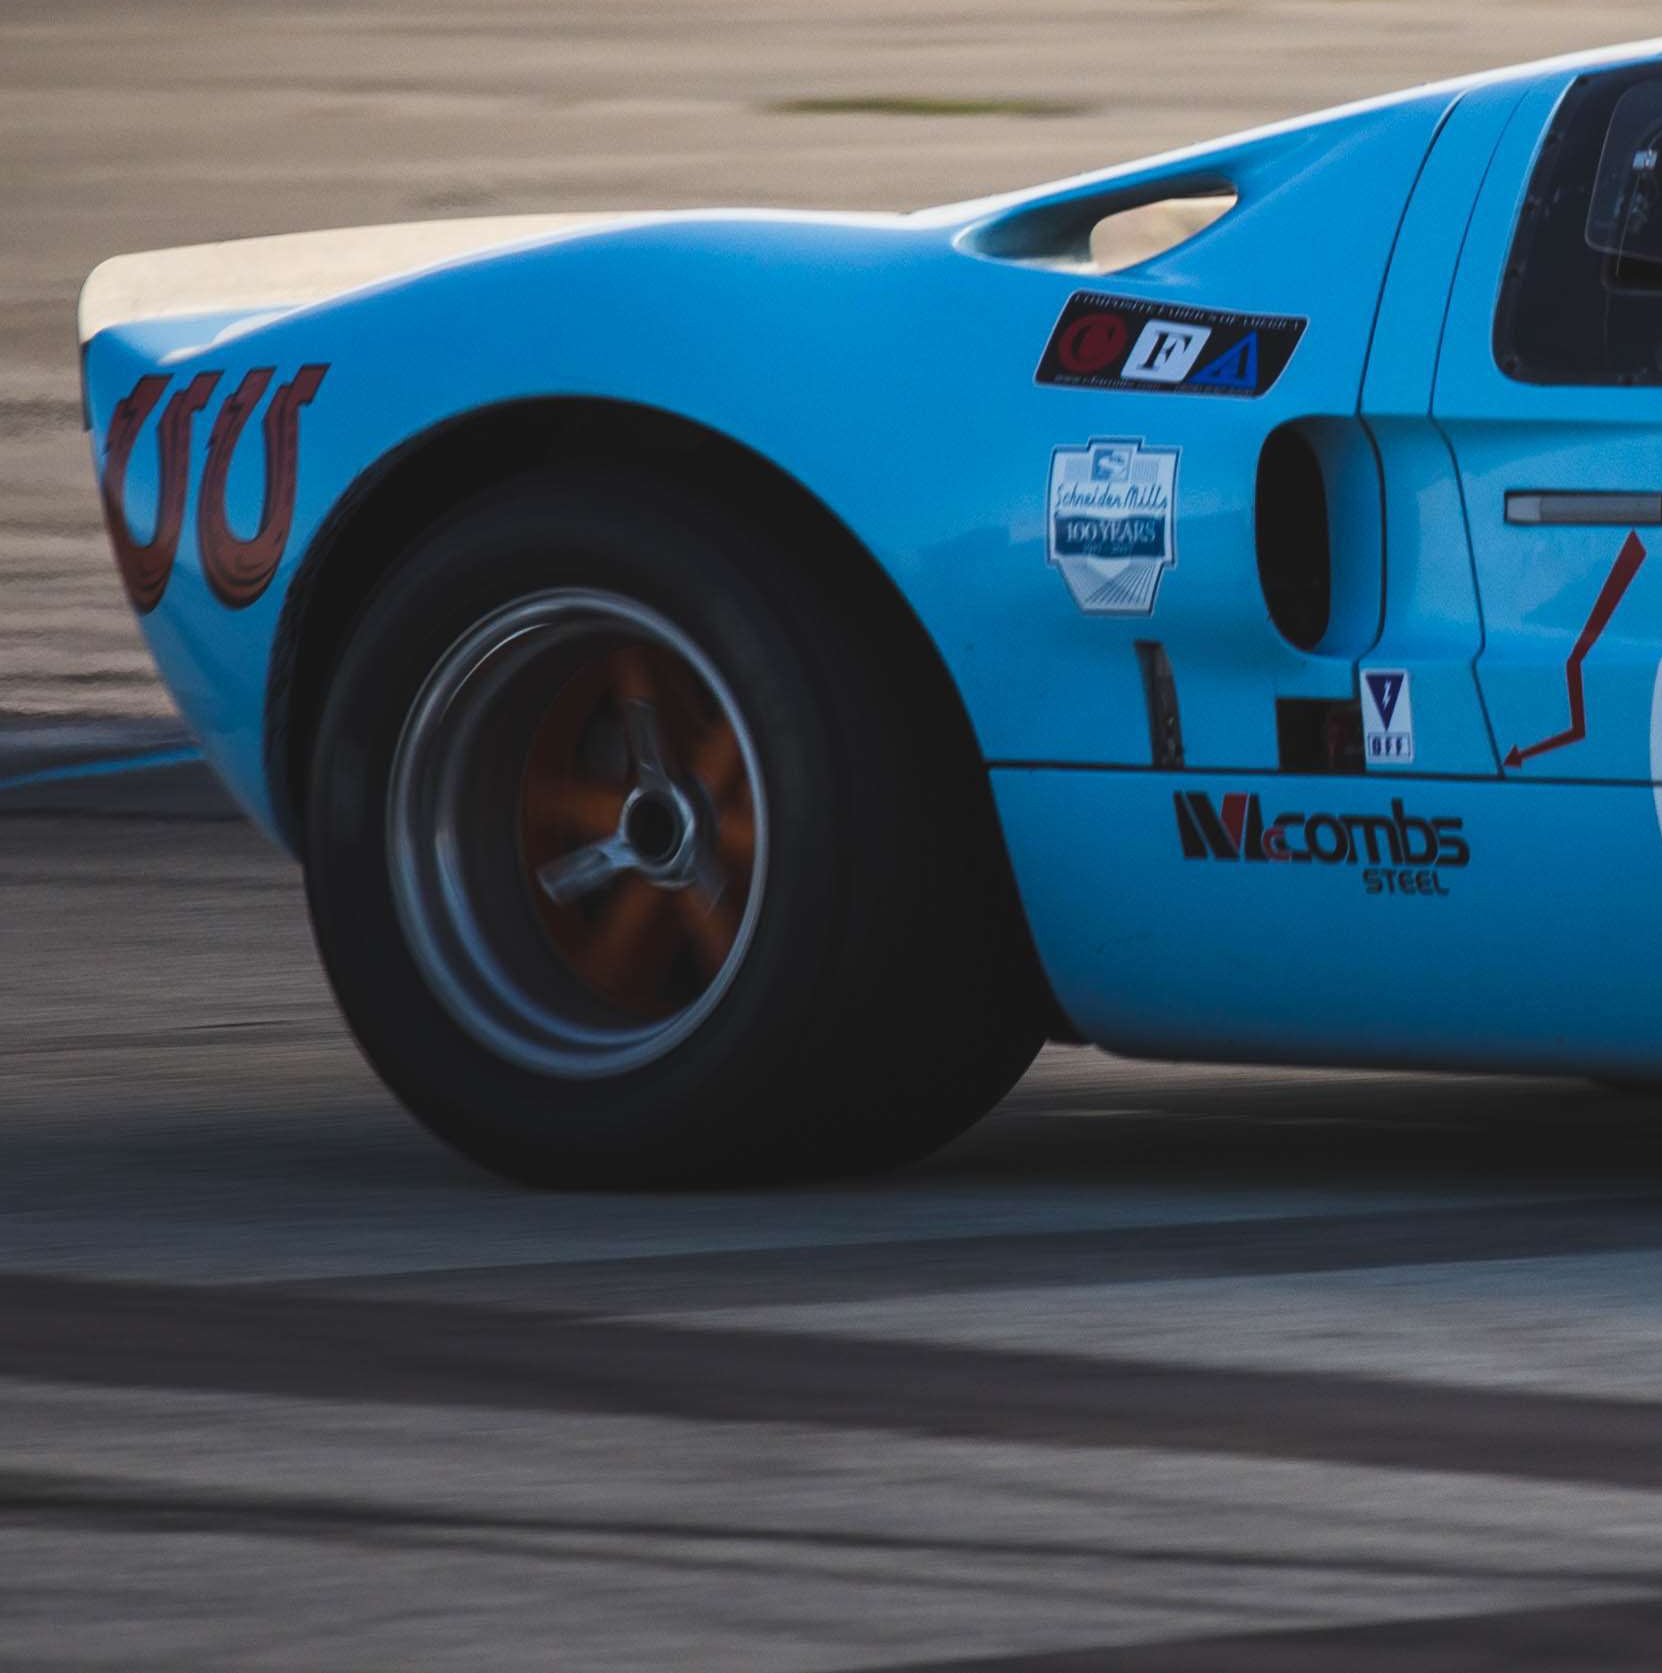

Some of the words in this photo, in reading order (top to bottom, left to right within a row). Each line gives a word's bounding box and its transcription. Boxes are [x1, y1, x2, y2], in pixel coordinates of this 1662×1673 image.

[1123, 481, 1168, 510] Mills
[1066, 520, 1098, 543] 100
[1099, 519, 1157, 544] YEARS
[1371, 734, 1407, 758] OFF
[1362, 868, 1450, 896] STEEL
